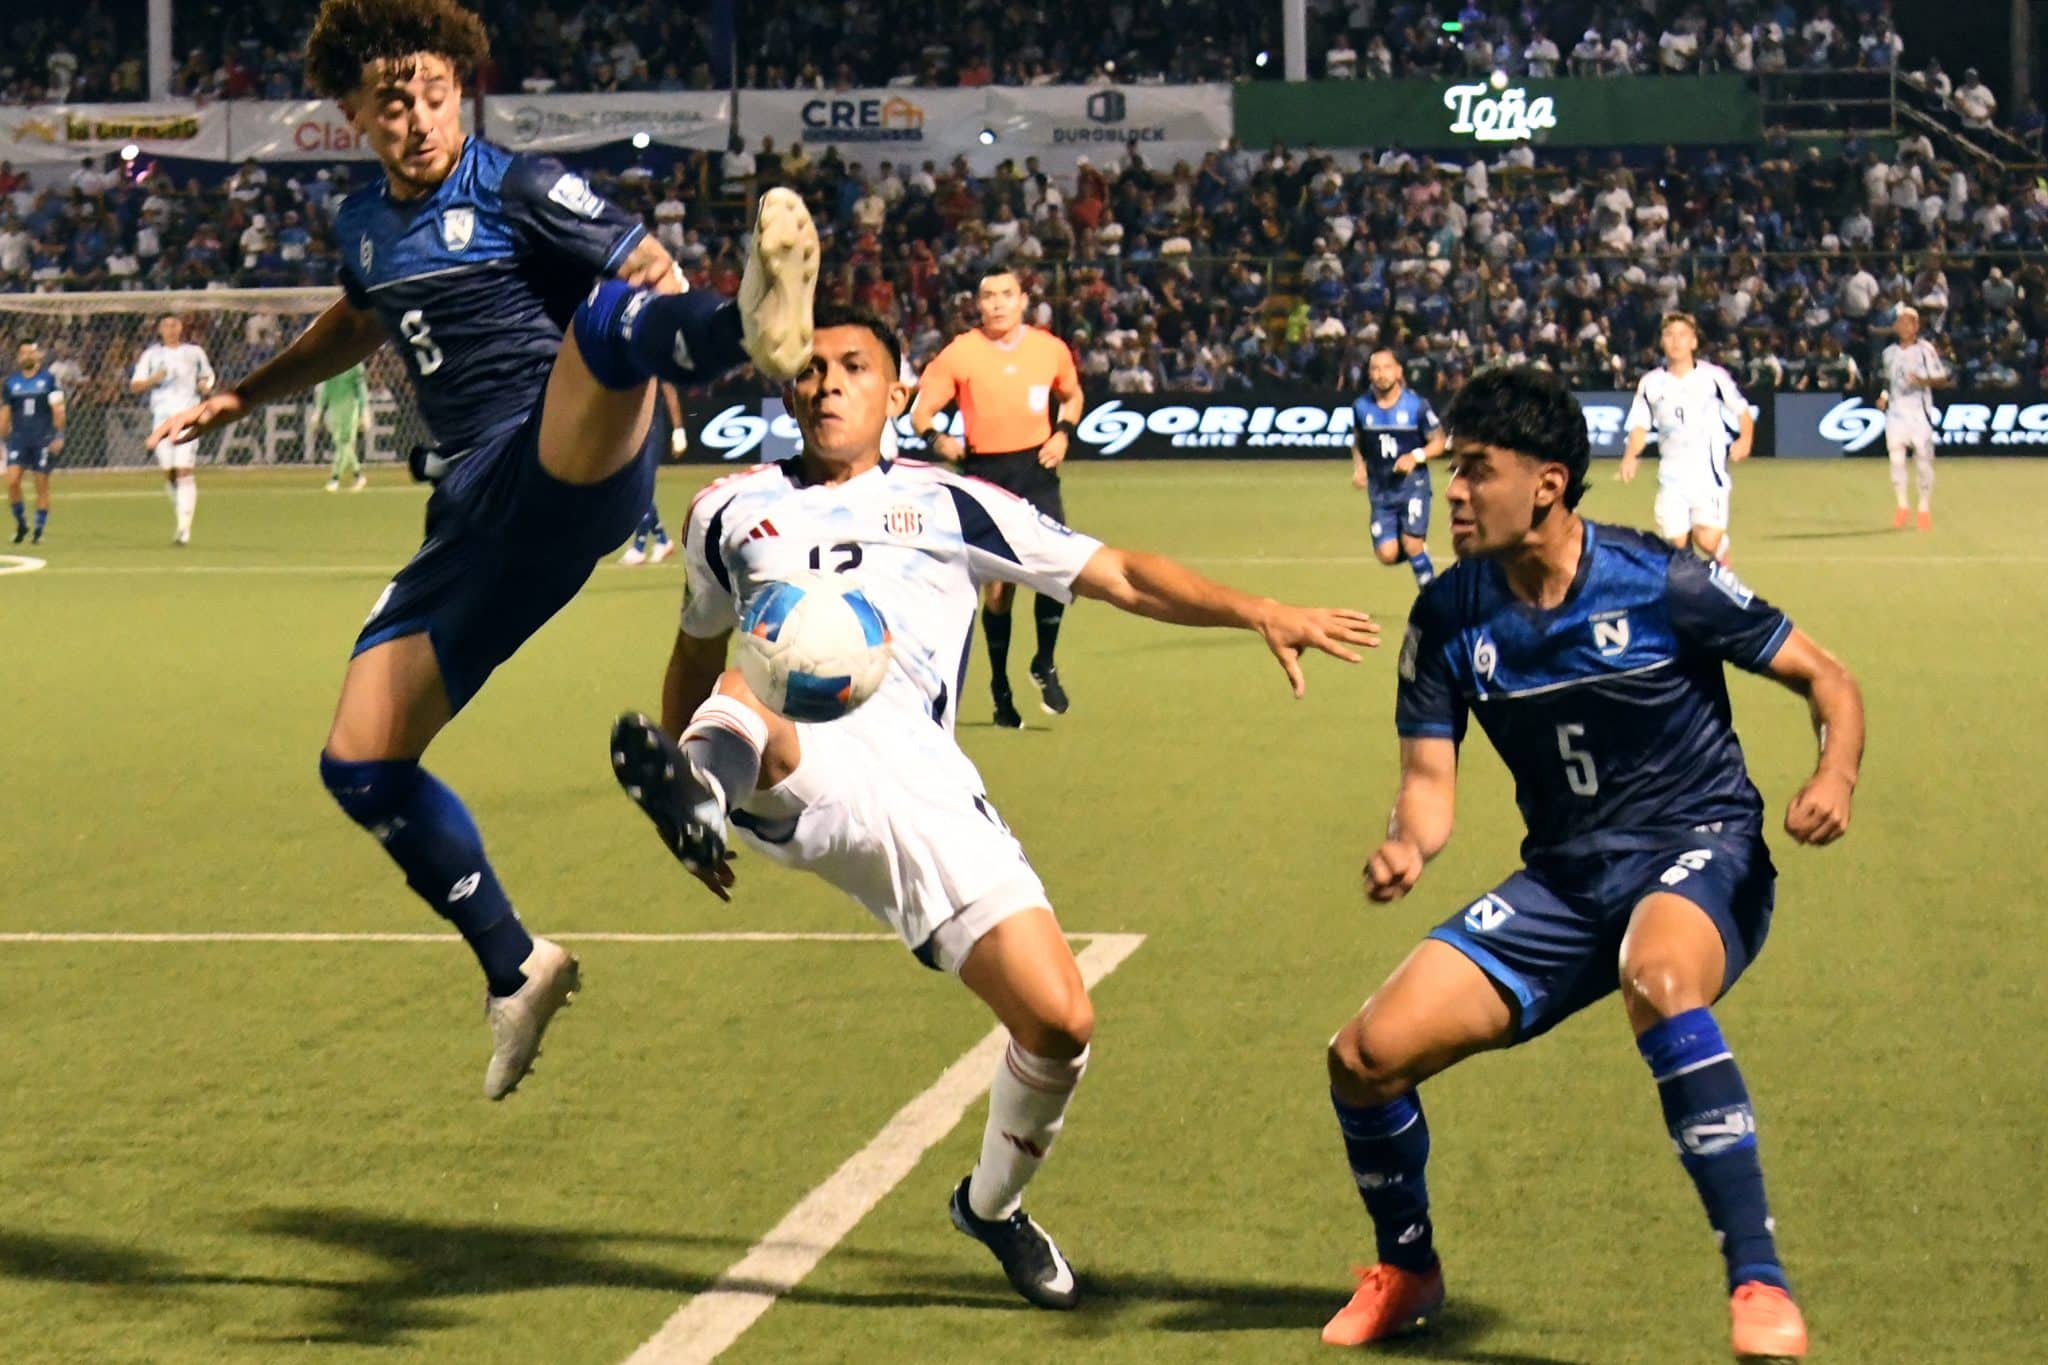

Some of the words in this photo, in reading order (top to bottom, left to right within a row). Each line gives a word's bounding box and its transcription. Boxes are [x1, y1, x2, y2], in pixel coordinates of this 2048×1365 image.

[1444, 82, 1557, 141] Toña
[1171, 432, 1239, 447] ELITE
[1556, 723, 1600, 797] 5
